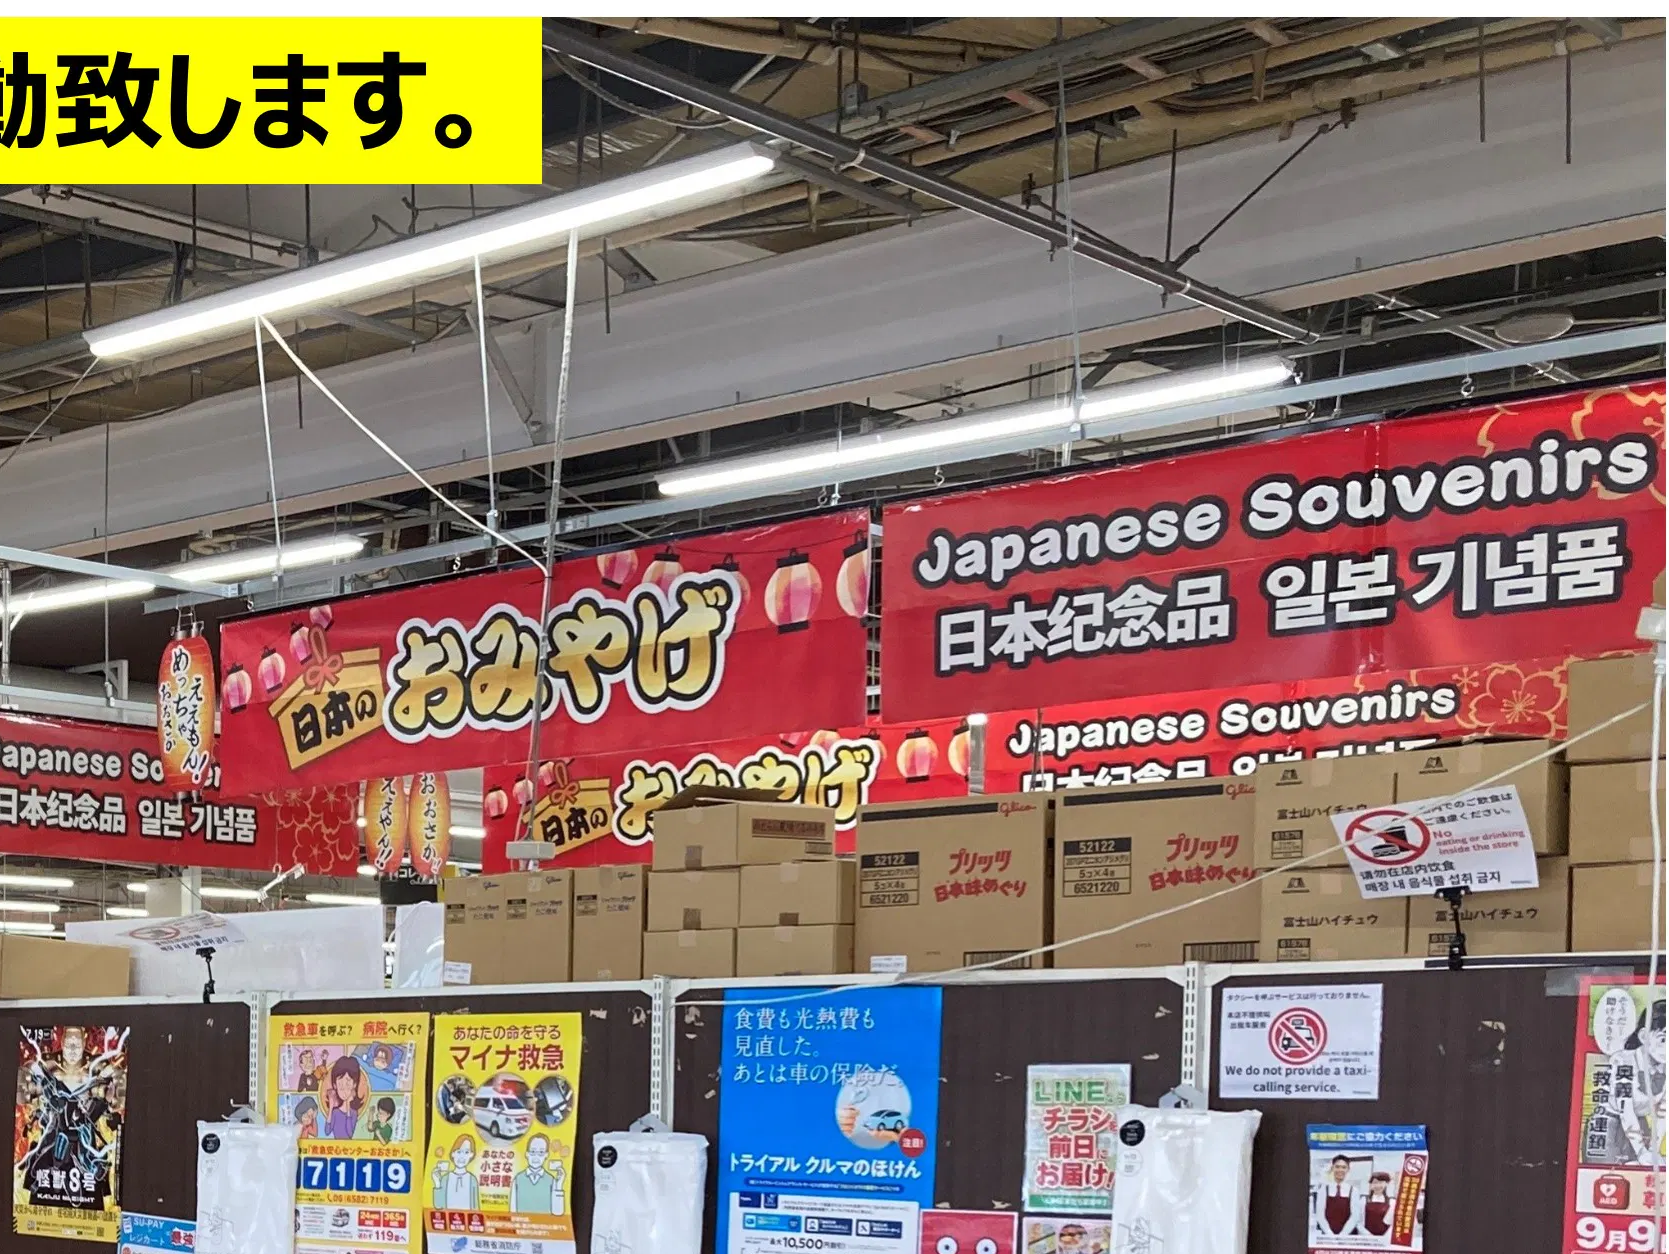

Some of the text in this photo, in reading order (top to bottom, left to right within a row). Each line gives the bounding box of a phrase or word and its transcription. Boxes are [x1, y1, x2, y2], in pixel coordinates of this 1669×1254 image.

[917, 441, 1648, 586] Japanese Souvenirs
[1268, 527, 1623, 627] 일본 기념품
[940, 576, 1230, 668] 日本纪念品
[389, 577, 734, 740] おみやげ
[292, 689, 378, 754] 日本の
[1010, 684, 1457, 756] Japanese Souvenirs
[138, 800, 257, 843] 일본 기념품
[541, 805, 607, 847] 日本の
[1079, 840, 1115, 853] 52122
[1433, 831, 1452, 839] No
[1436, 837, 1467, 847] eating
[1482, 830, 1525, 842] drinking
[1166, 833, 1239, 861] プリッツ
[1439, 841, 1519, 856] inside the store
[874, 855, 906, 866] 52122
[949, 849, 1012, 876] プリッツ
[1360, 861, 1455, 880] 请勿在店内饮食
[1074, 881, 1120, 894] 6521220
[1149, 865, 1257, 891] 日本味めぐり
[1365, 880, 1389, 892] 매장
[1393, 878, 1405, 889] 내
[1449, 873, 1472, 885] 섭취
[1476, 871, 1501, 884] 금지
[934, 878, 1028, 902] 日本味めぐり
[1283, 915, 1378, 928] 富士山ハイチュウ
[284, 1021, 422, 1038] 救急車を呼ぶ? 病院へ行く?
[734, 1007, 875, 1031] 食費も光熱費も
[453, 1024, 561, 1041] あなたの命を守る
[449, 1044, 564, 1071] マイナ救急
[734, 1035, 820, 1058] 見直した。
[1225, 1064, 1372, 1079] We do not provide a taxi-
[1253, 1082, 1340, 1094] calling service.
[1615, 1064, 1633, 1114] 奥義!
[482, 1150, 514, 1160] あなたの
[730, 1152, 922, 1180] トライアル クルマのほけん
[480, 1161, 513, 1173] 小さな
[1036, 1162, 1115, 1188] お届け!
[36, 1167, 96, 1193] 怪獣8号
[479, 1174, 512, 1188] 説明書
[133, 1217, 164, 1229] SU-PAY
